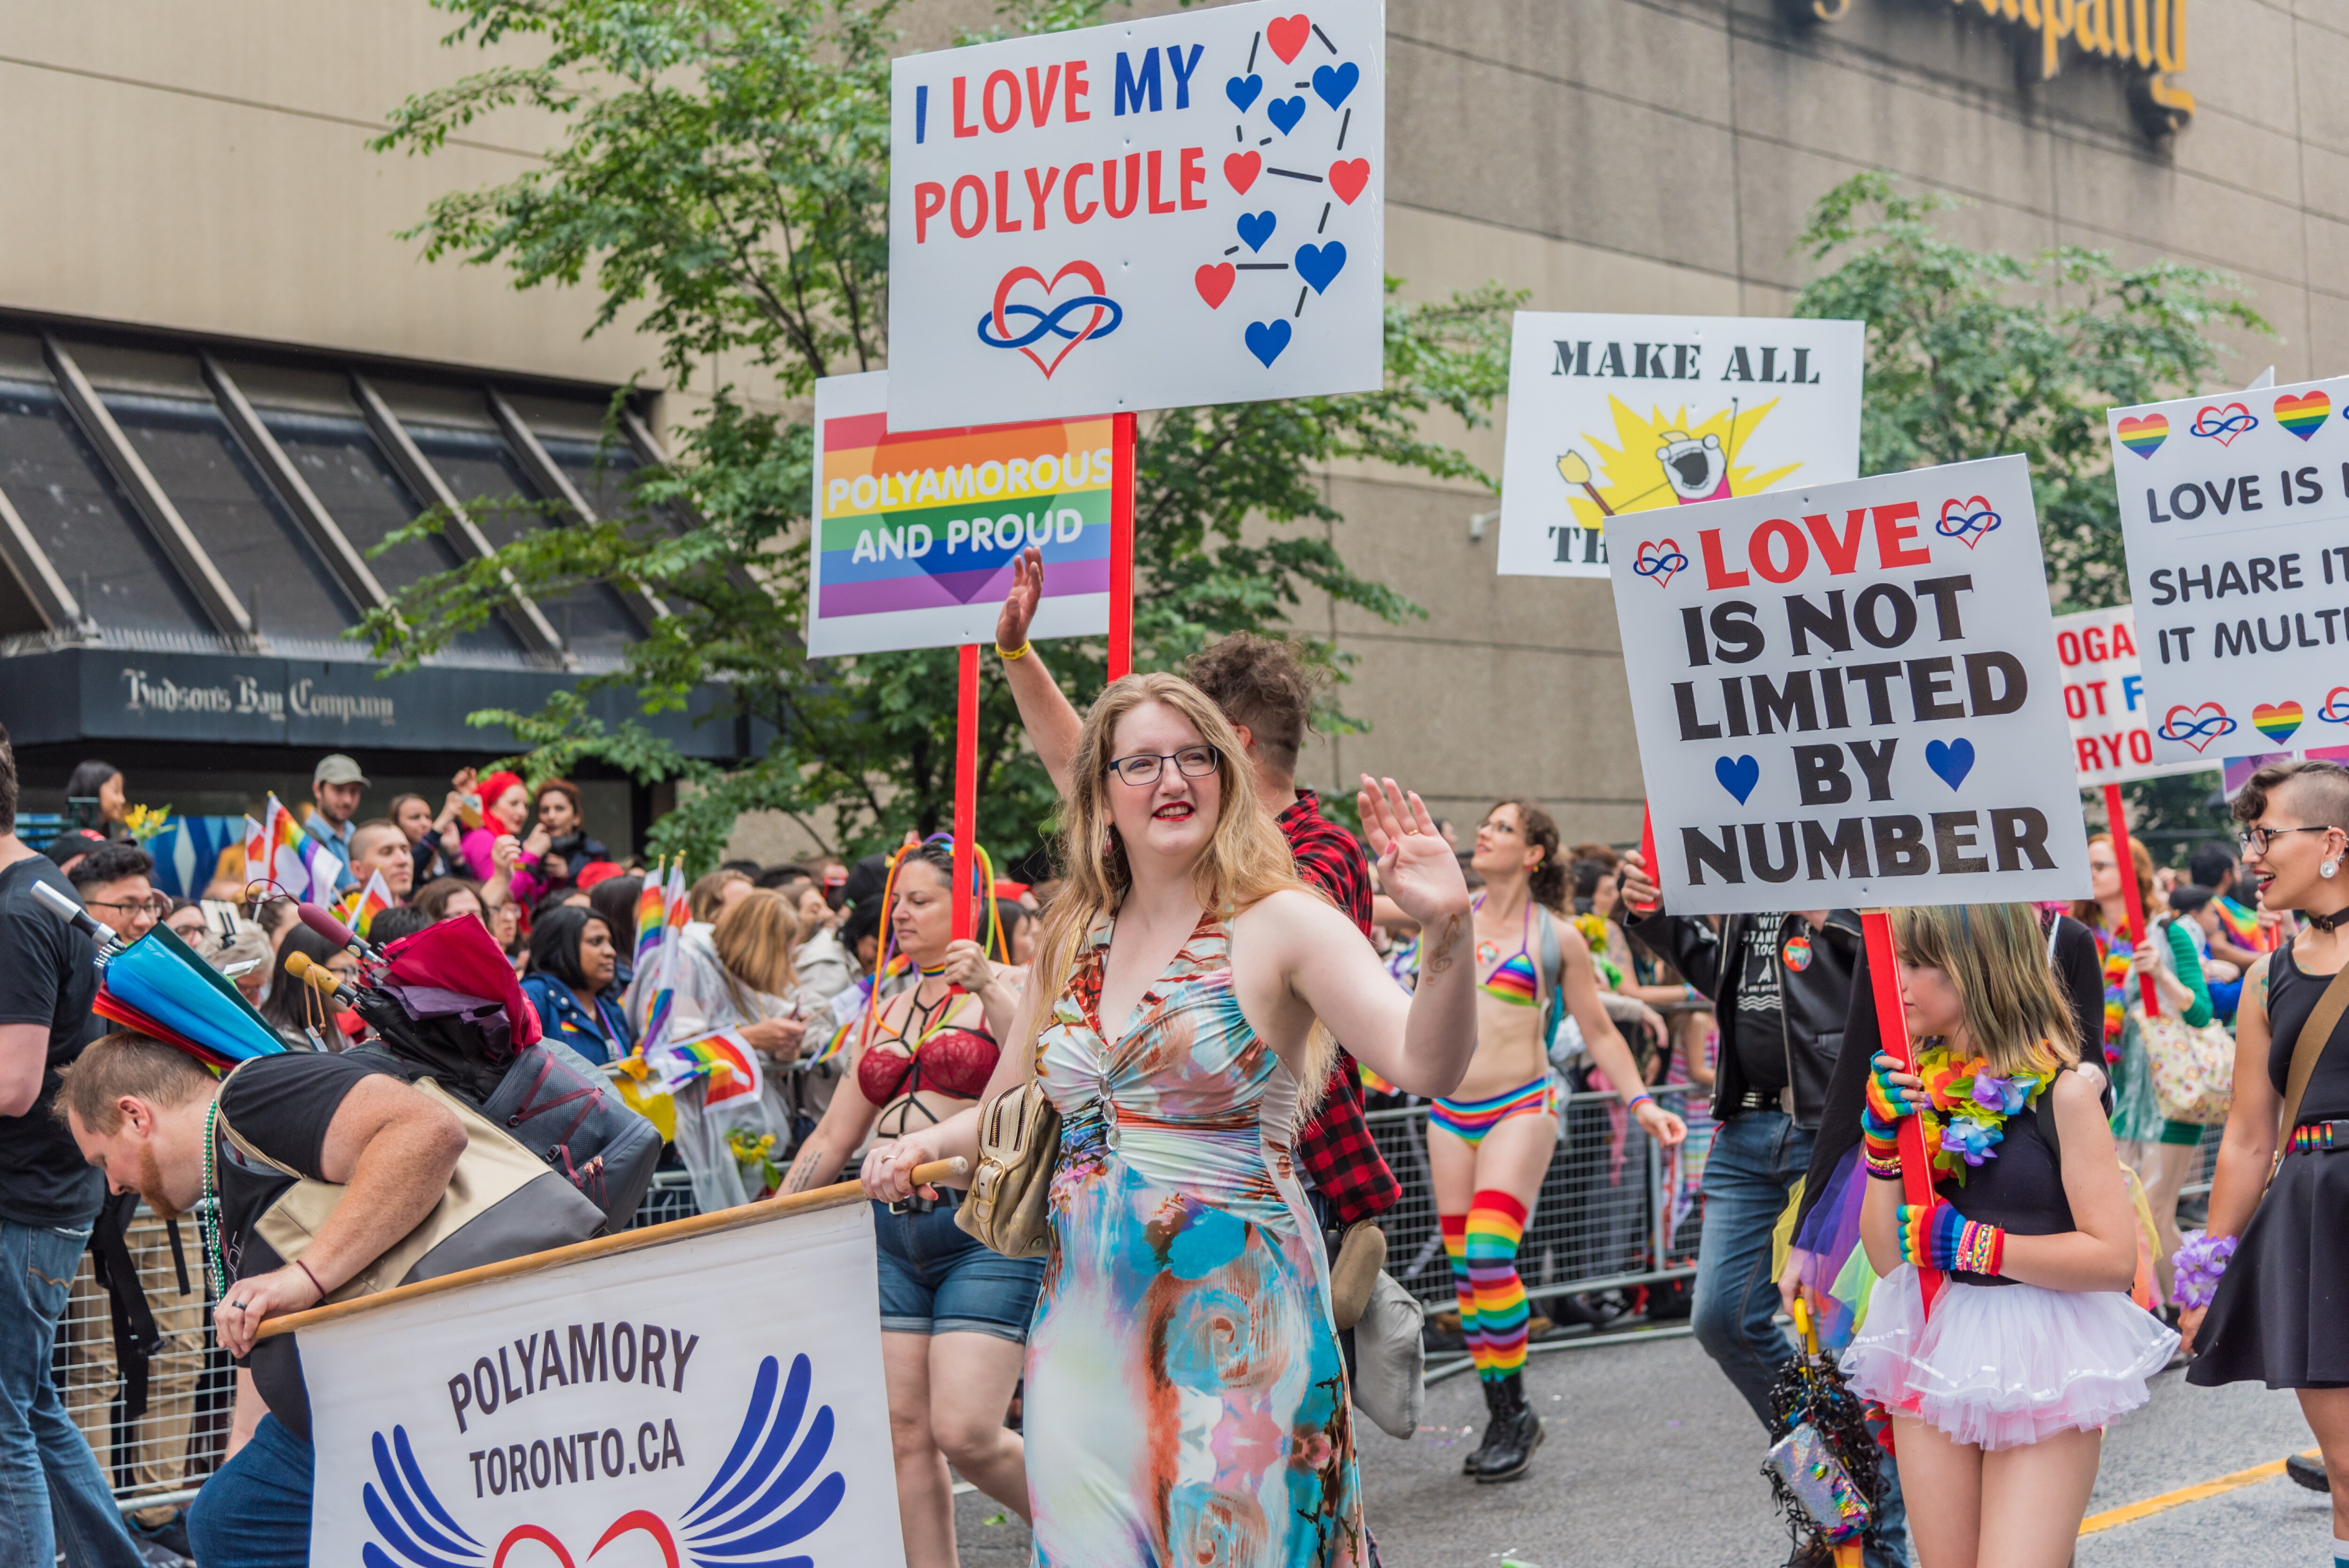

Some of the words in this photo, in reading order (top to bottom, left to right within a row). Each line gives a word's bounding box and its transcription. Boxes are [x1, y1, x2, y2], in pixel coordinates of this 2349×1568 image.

[916, 85, 928, 145] I
[953, 60, 1090, 138] LOVE
[1114, 43, 1205, 116] MY
[915, 147, 1207, 244] POLYCULE
[1552, 340, 1701, 380] MAKE
[1720, 346, 1820, 384] ALL
[828, 448, 1112, 512] POLYAMOROUS
[2147, 475, 2263, 523] LOVE
[2281, 467, 2323, 506] IS
[852, 524, 933, 564] AND
[947, 508, 1083, 555] PROUD
[1697, 501, 1931, 591] LOVE
[2150, 553, 2303, 605] SHARE
[2322, 547, 2349, 584] IT
[1679, 600, 1765, 668] IS
[1783, 574, 1974, 657] NOT
[2057, 622, 2137, 667] OGA
[2159, 627, 2195, 664] IT
[235, 675, 287, 722] Bay
[289, 678, 396, 726] Company
[1671, 651, 2028, 741] LIMITED
[1790, 737, 1899, 807] BY
[2075, 729, 2153, 773] RYO
[1679, 807, 2059, 886] NUMBER
[1753, 943, 1777, 957] ROC
[1758, 916, 1782, 930] WIT
[447, 1321, 700, 1435] POLYAMORY
[469, 1418, 685, 1498] TORONTO.CA
